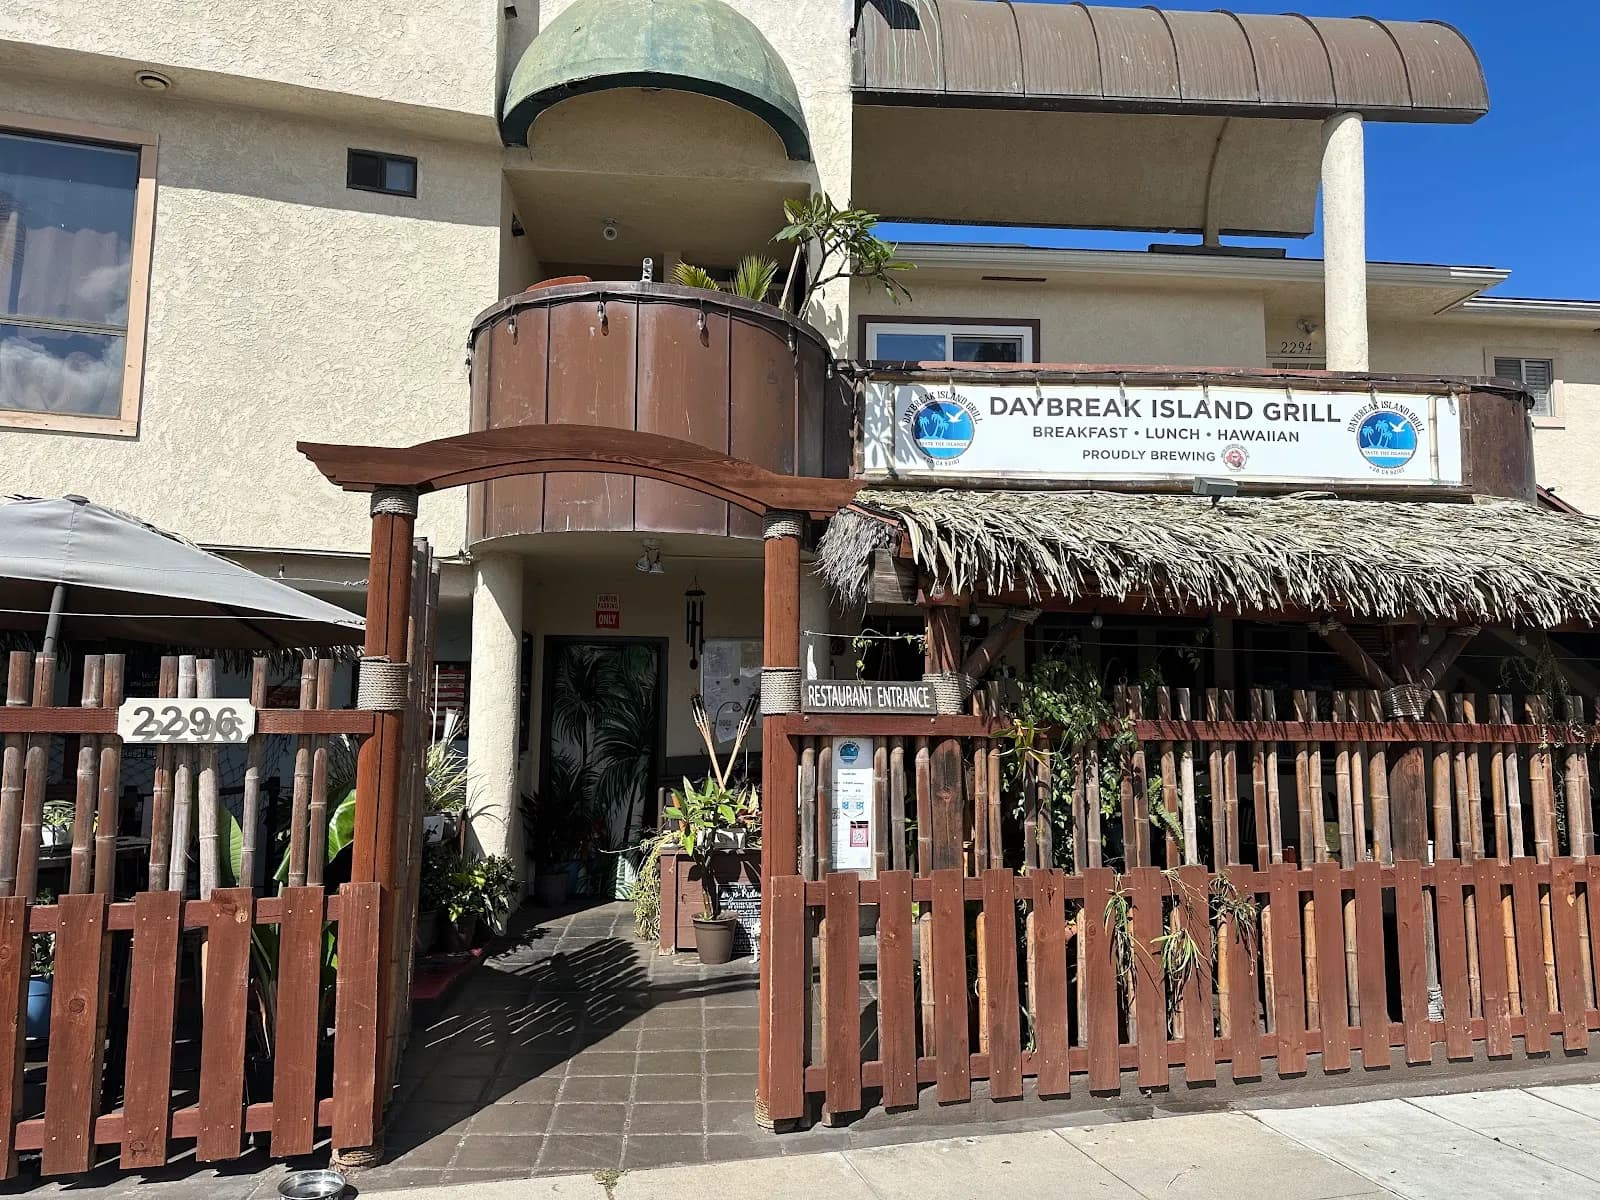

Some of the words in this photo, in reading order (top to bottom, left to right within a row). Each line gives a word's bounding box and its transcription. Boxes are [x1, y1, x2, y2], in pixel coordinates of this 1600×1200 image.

[1281, 341, 1312, 354] 2294
[903, 391, 936, 424] DAYBREAK
[937, 390, 967, 405] ISLAND
[965, 401, 983, 424] GRILL
[990, 396, 1142, 418] DAYBREAK
[1152, 399, 1253, 420] ISLAND
[1263, 403, 1341, 423] GRILL
[1347, 401, 1379, 433] DAYBREAK
[1380, 400, 1410, 415] ISLAND
[1408, 412, 1425, 434] GRILL
[1033, 426, 1128, 439] BREAKFAST
[1145, 428, 1200, 440] LUNCH
[1218, 429, 1300, 442] HAWAIIAN
[1082, 449, 1146, 461] PROUDLY
[1151, 450, 1216, 462] BREWING
[598, 614, 617, 625] ONLY
[808, 685, 873, 707] RESTAURANT
[877, 686, 930, 708] ENTRANCE
[132, 705, 237, 737] 2296
